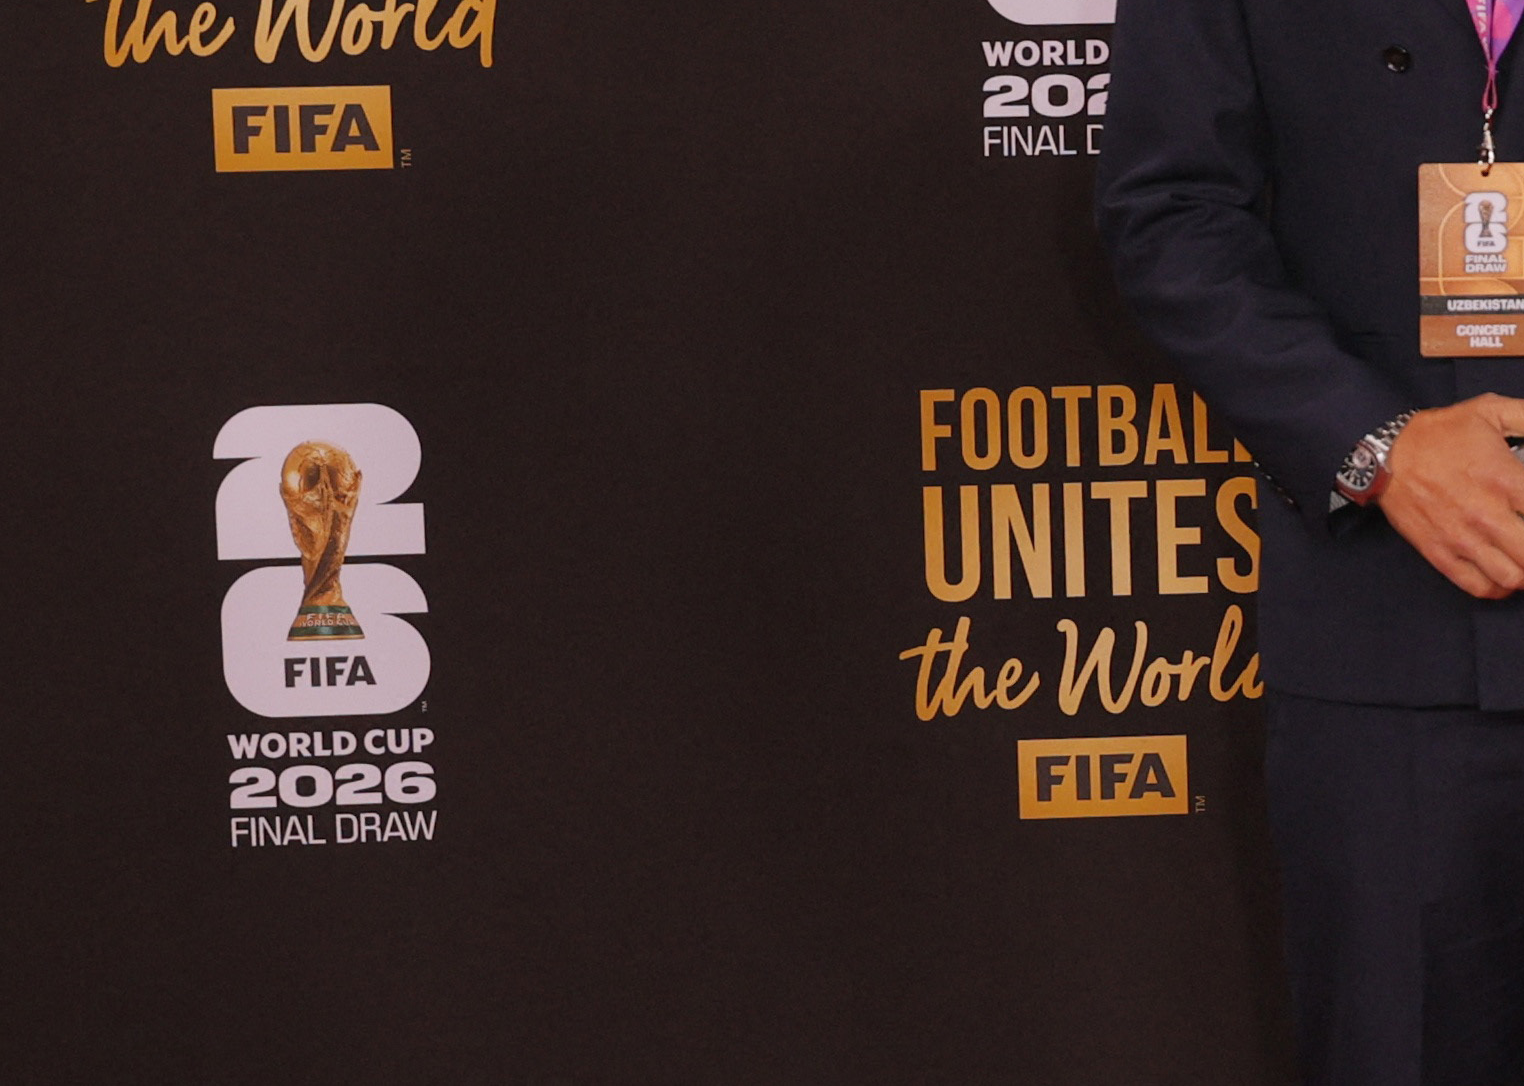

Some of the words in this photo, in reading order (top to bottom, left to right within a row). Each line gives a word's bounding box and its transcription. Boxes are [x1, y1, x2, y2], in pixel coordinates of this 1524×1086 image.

[982, 40, 1110, 67] WORLD
[983, 73, 1111, 117] 20
[231, 104, 380, 154] FIFA
[984, 125, 1077, 156] FINAL
[1465, 254, 1506, 263] FINAL
[1465, 263, 1507, 273] DRAW
[1456, 324, 1518, 336] CONCERT
[1470, 336, 1503, 348] HALL
[920, 384, 1254, 471] FOOTBAL
[923, 477, 1261, 602] UNITES
[284, 656, 377, 688] FIFA
[899, 617, 1040, 721] the
[227, 730, 357, 759] WORLD
[364, 728, 434, 755] CUP
[229, 761, 436, 809] 2026
[1035, 752, 1176, 802] FIFA
[231, 815, 326, 847] FINAL
[336, 810, 437, 843] DRAW
